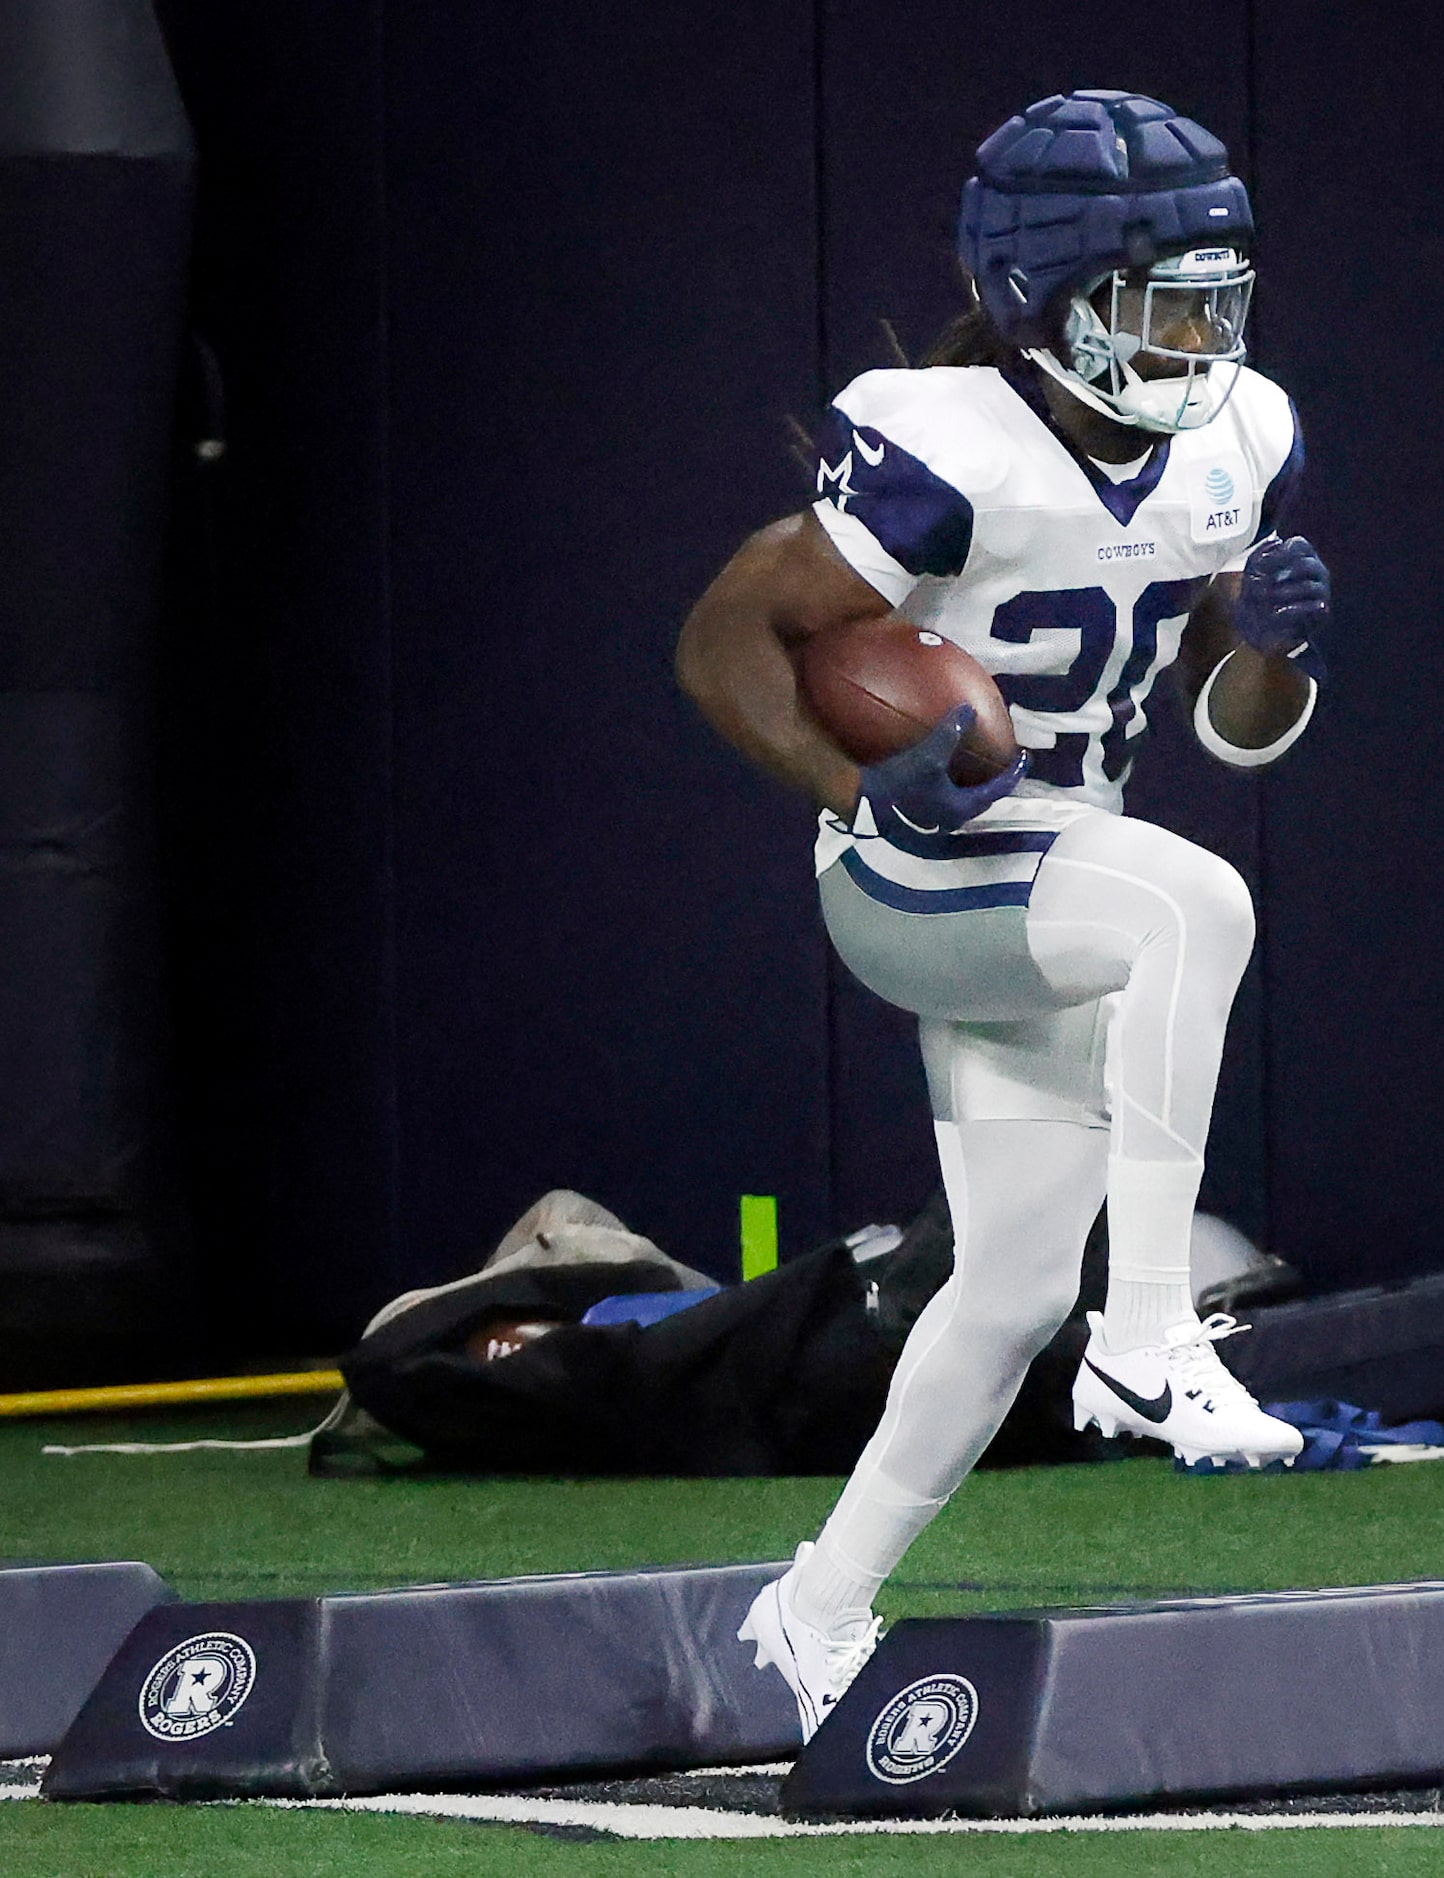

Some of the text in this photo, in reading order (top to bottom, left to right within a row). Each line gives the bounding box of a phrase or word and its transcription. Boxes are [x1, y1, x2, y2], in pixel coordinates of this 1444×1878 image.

[1205, 509, 1240, 531] AT&T
[1097, 542, 1155, 560] COWBOYS
[166, 1656, 227, 1715] R
[176, 1640, 232, 1663] ATHLETIC
[227, 1648, 248, 1705] COMPANY
[150, 1709, 221, 1735] ROGERS
[890, 1701, 949, 1755] R
